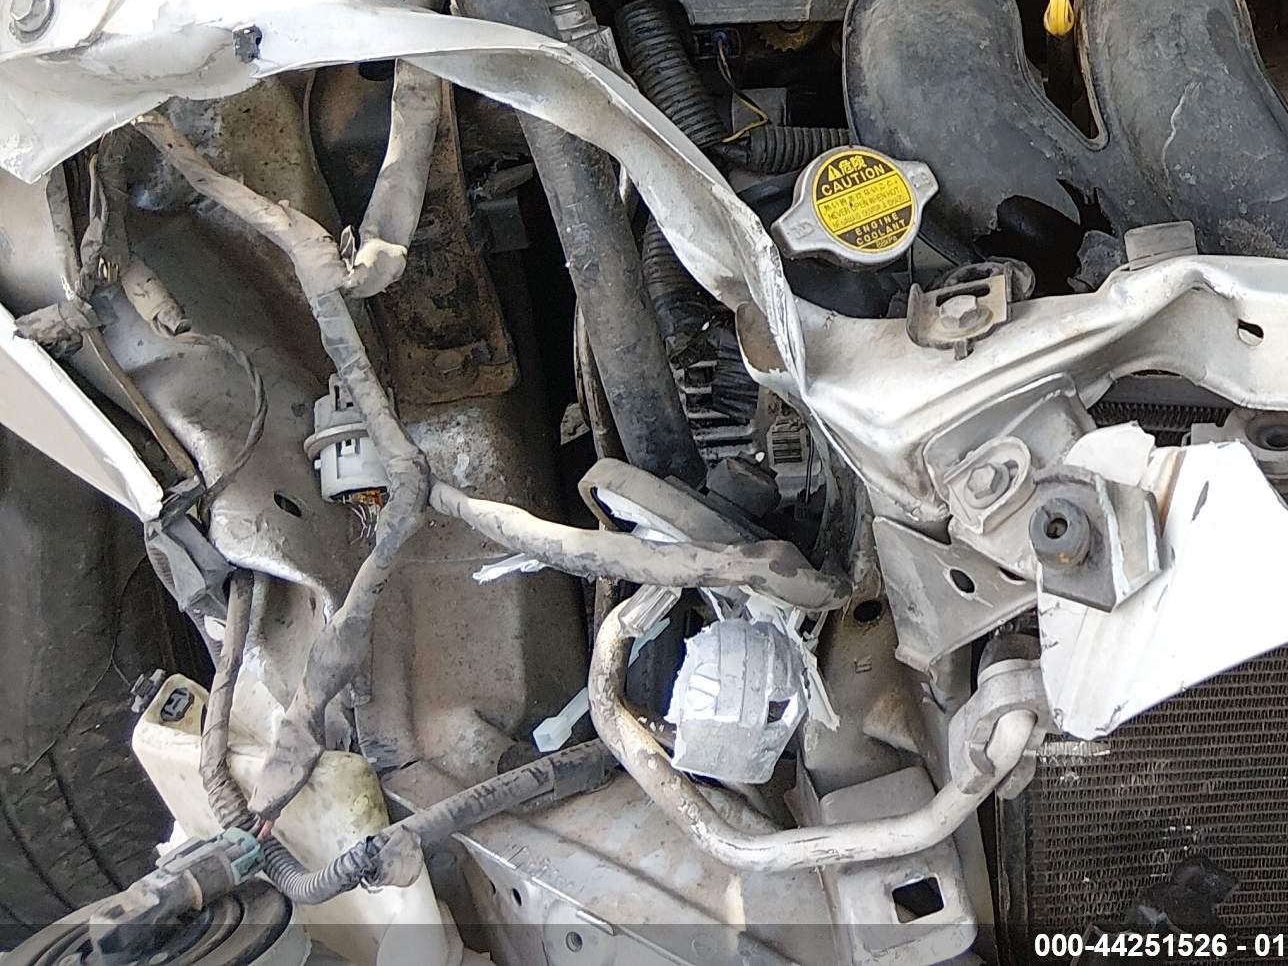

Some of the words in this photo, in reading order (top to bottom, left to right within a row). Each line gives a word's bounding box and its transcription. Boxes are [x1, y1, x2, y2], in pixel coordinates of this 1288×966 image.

[821, 164, 885, 195] CAUTION
[854, 213, 899, 235] ENGINE
[856, 221, 906, 244] COOLANT
